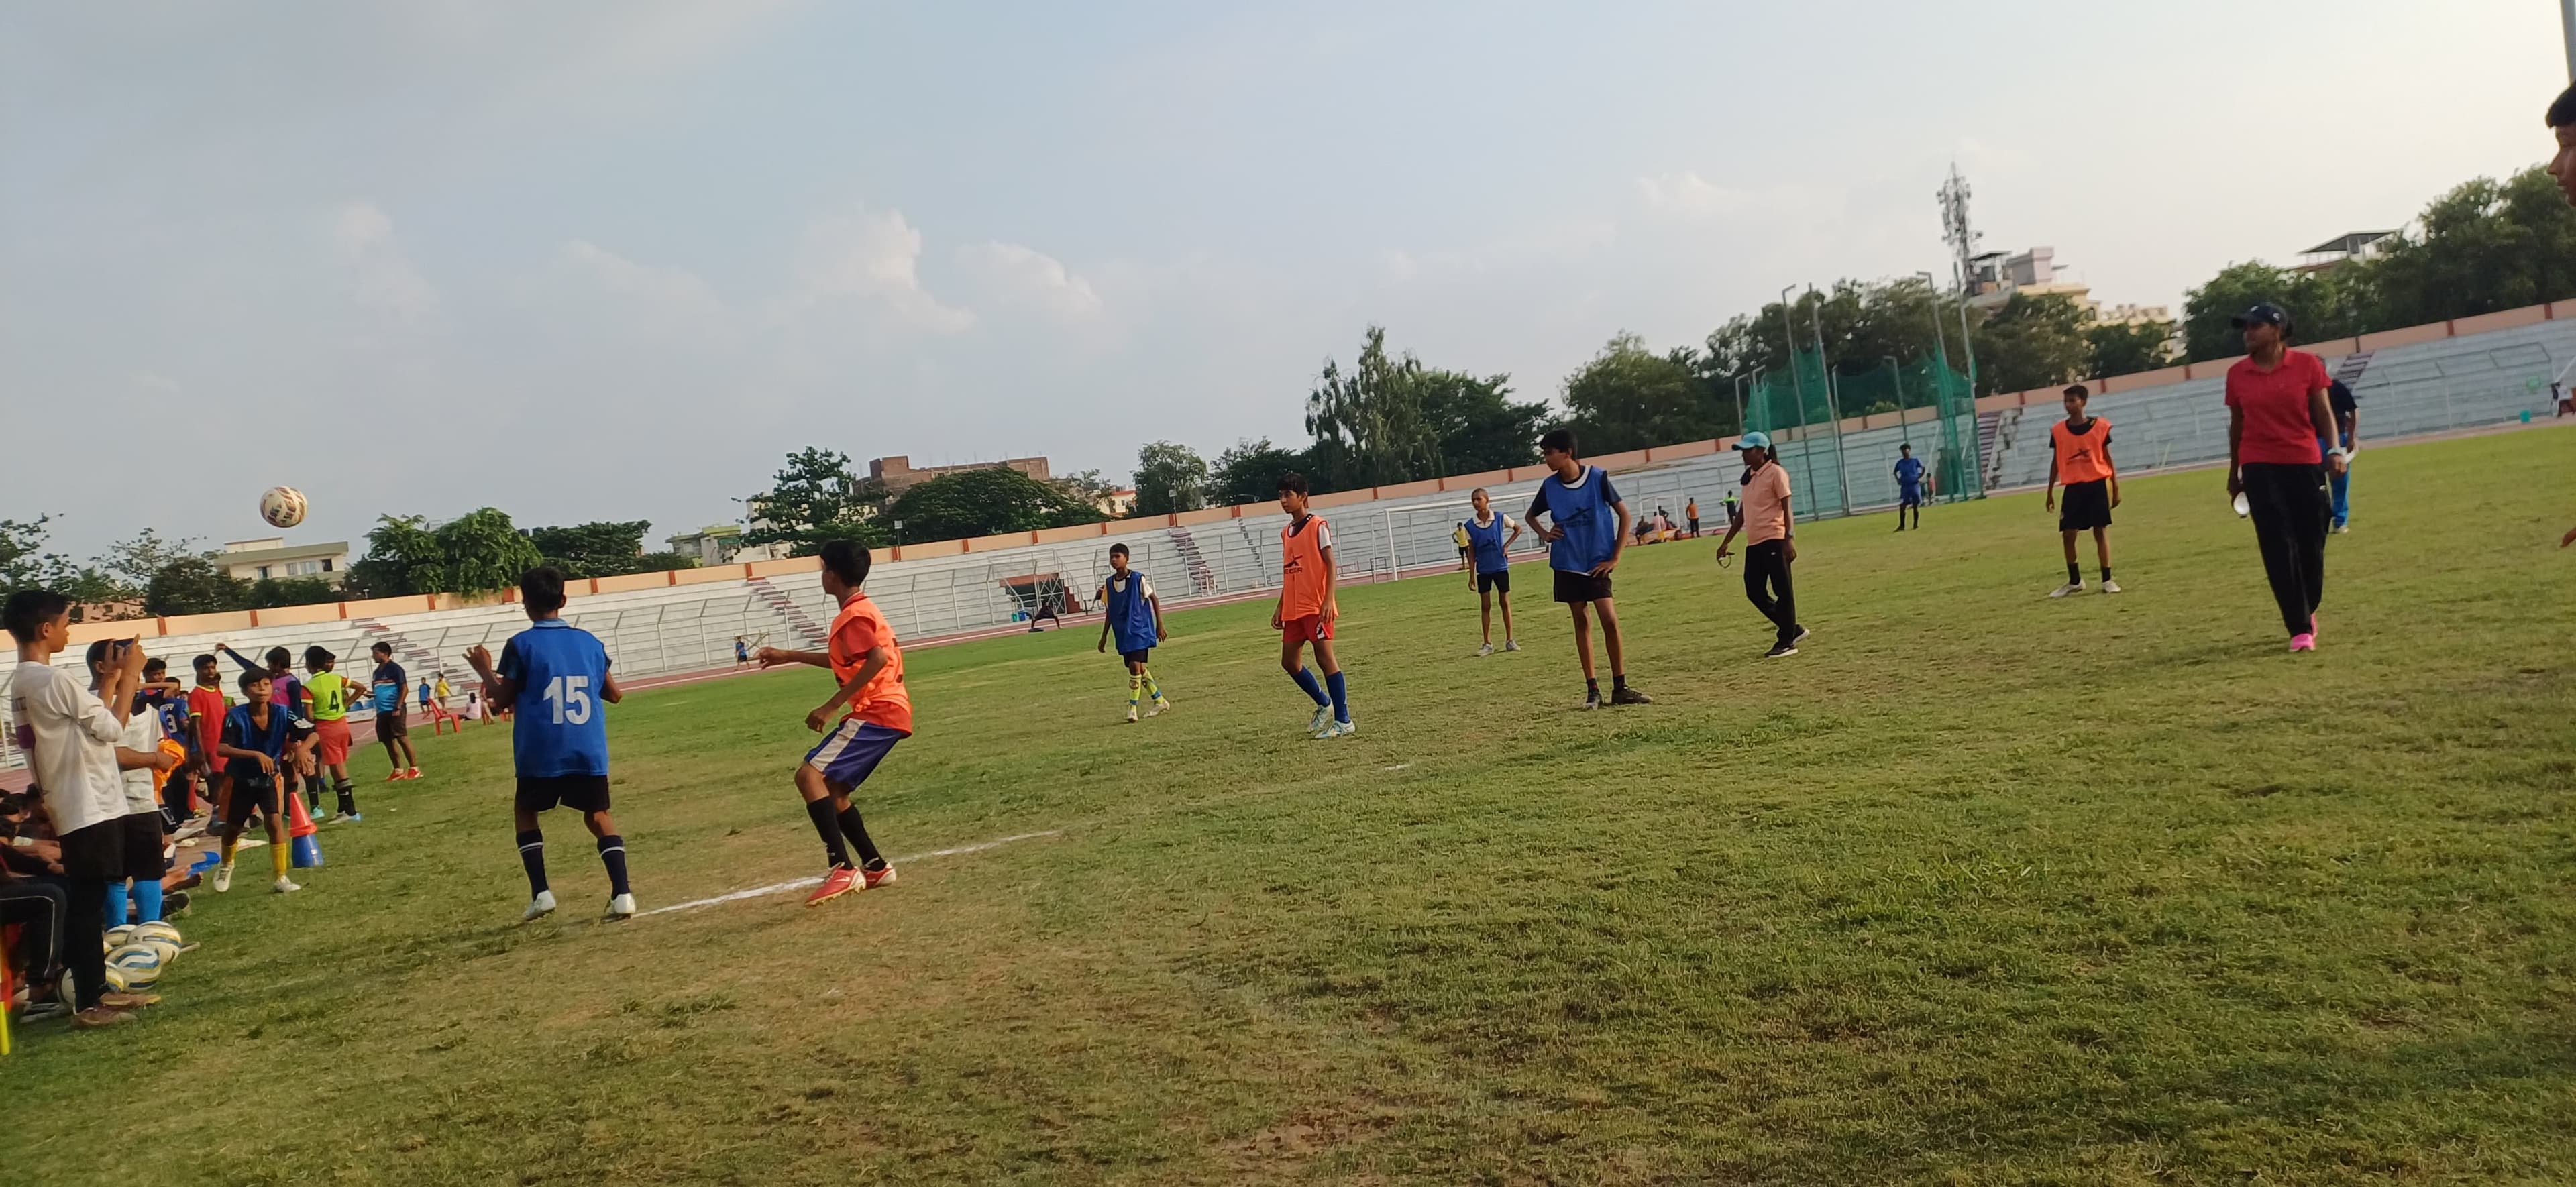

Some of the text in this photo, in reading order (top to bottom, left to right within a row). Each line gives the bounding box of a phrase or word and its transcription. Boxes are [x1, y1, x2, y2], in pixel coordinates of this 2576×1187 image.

[329, 689, 339, 713] 4
[543, 675, 591, 725] 15
[166, 714, 178, 734] 3
